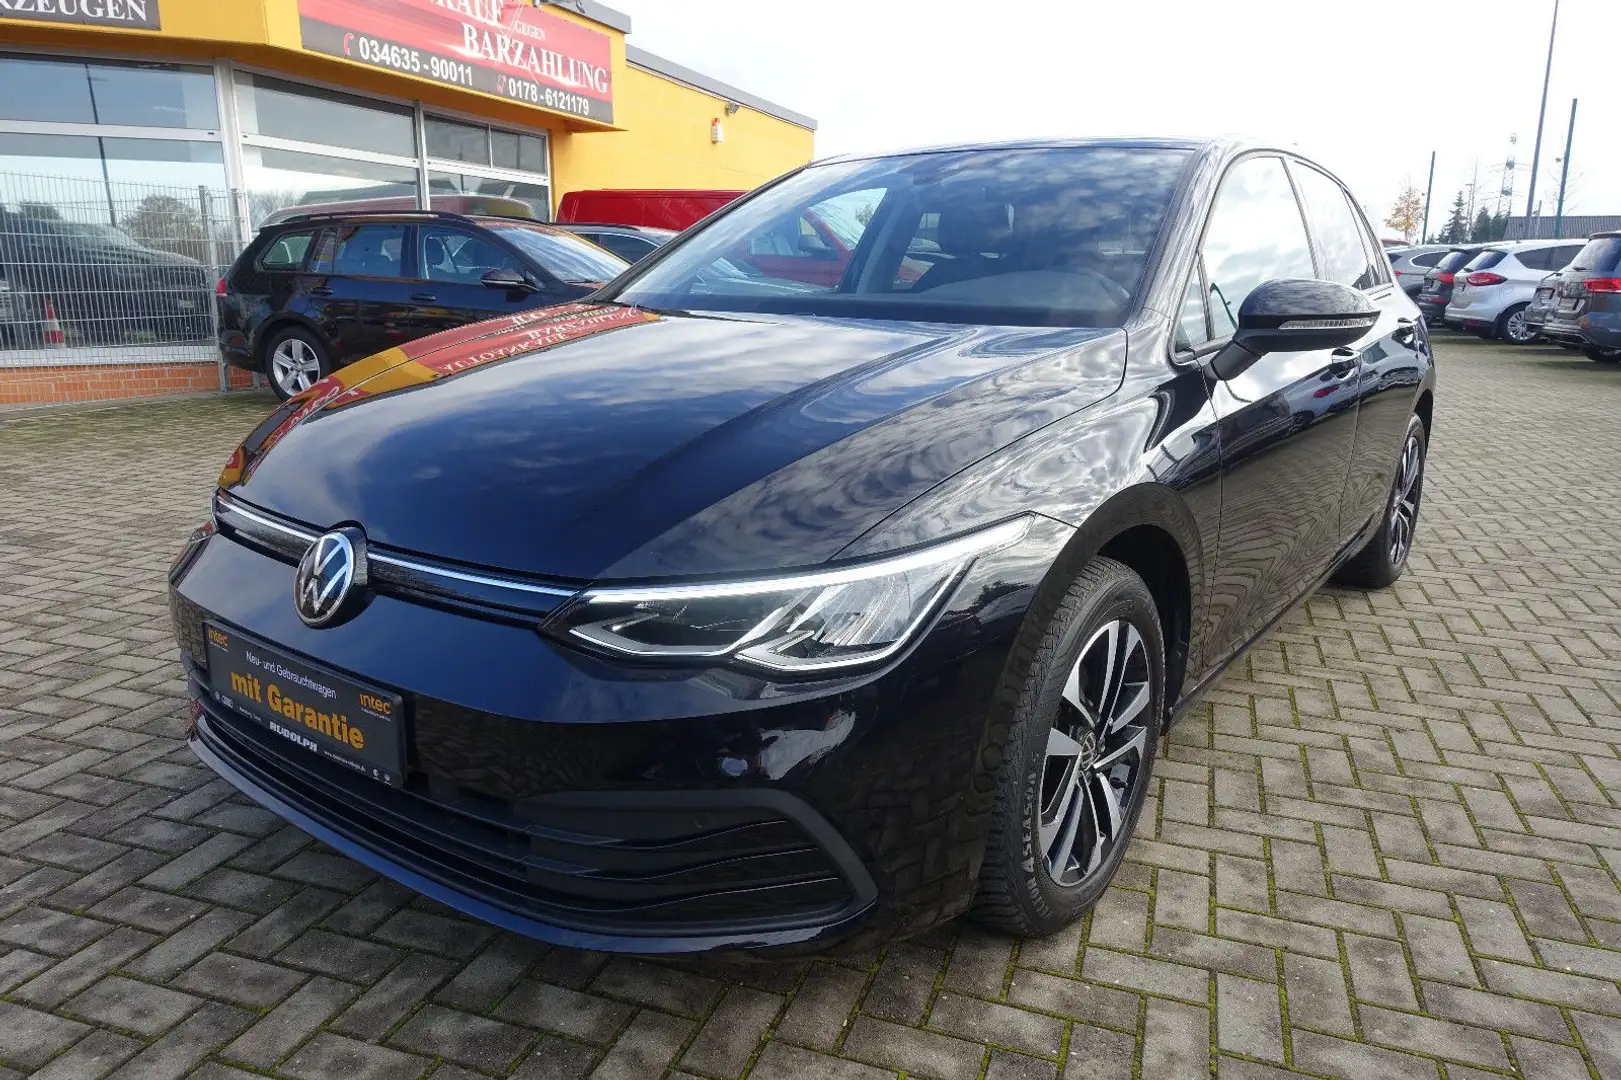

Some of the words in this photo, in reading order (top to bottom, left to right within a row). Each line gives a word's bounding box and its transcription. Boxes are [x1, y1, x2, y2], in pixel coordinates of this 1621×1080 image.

[514, 20, 546, 40] GEGEN
[461, 22, 608, 93] BARZAHLUNG
[263, 660, 276, 673] und
[231, 672, 262, 703] mit
[267, 683, 364, 750] Garantie
[269, 721, 318, 752] RUDOLPH
